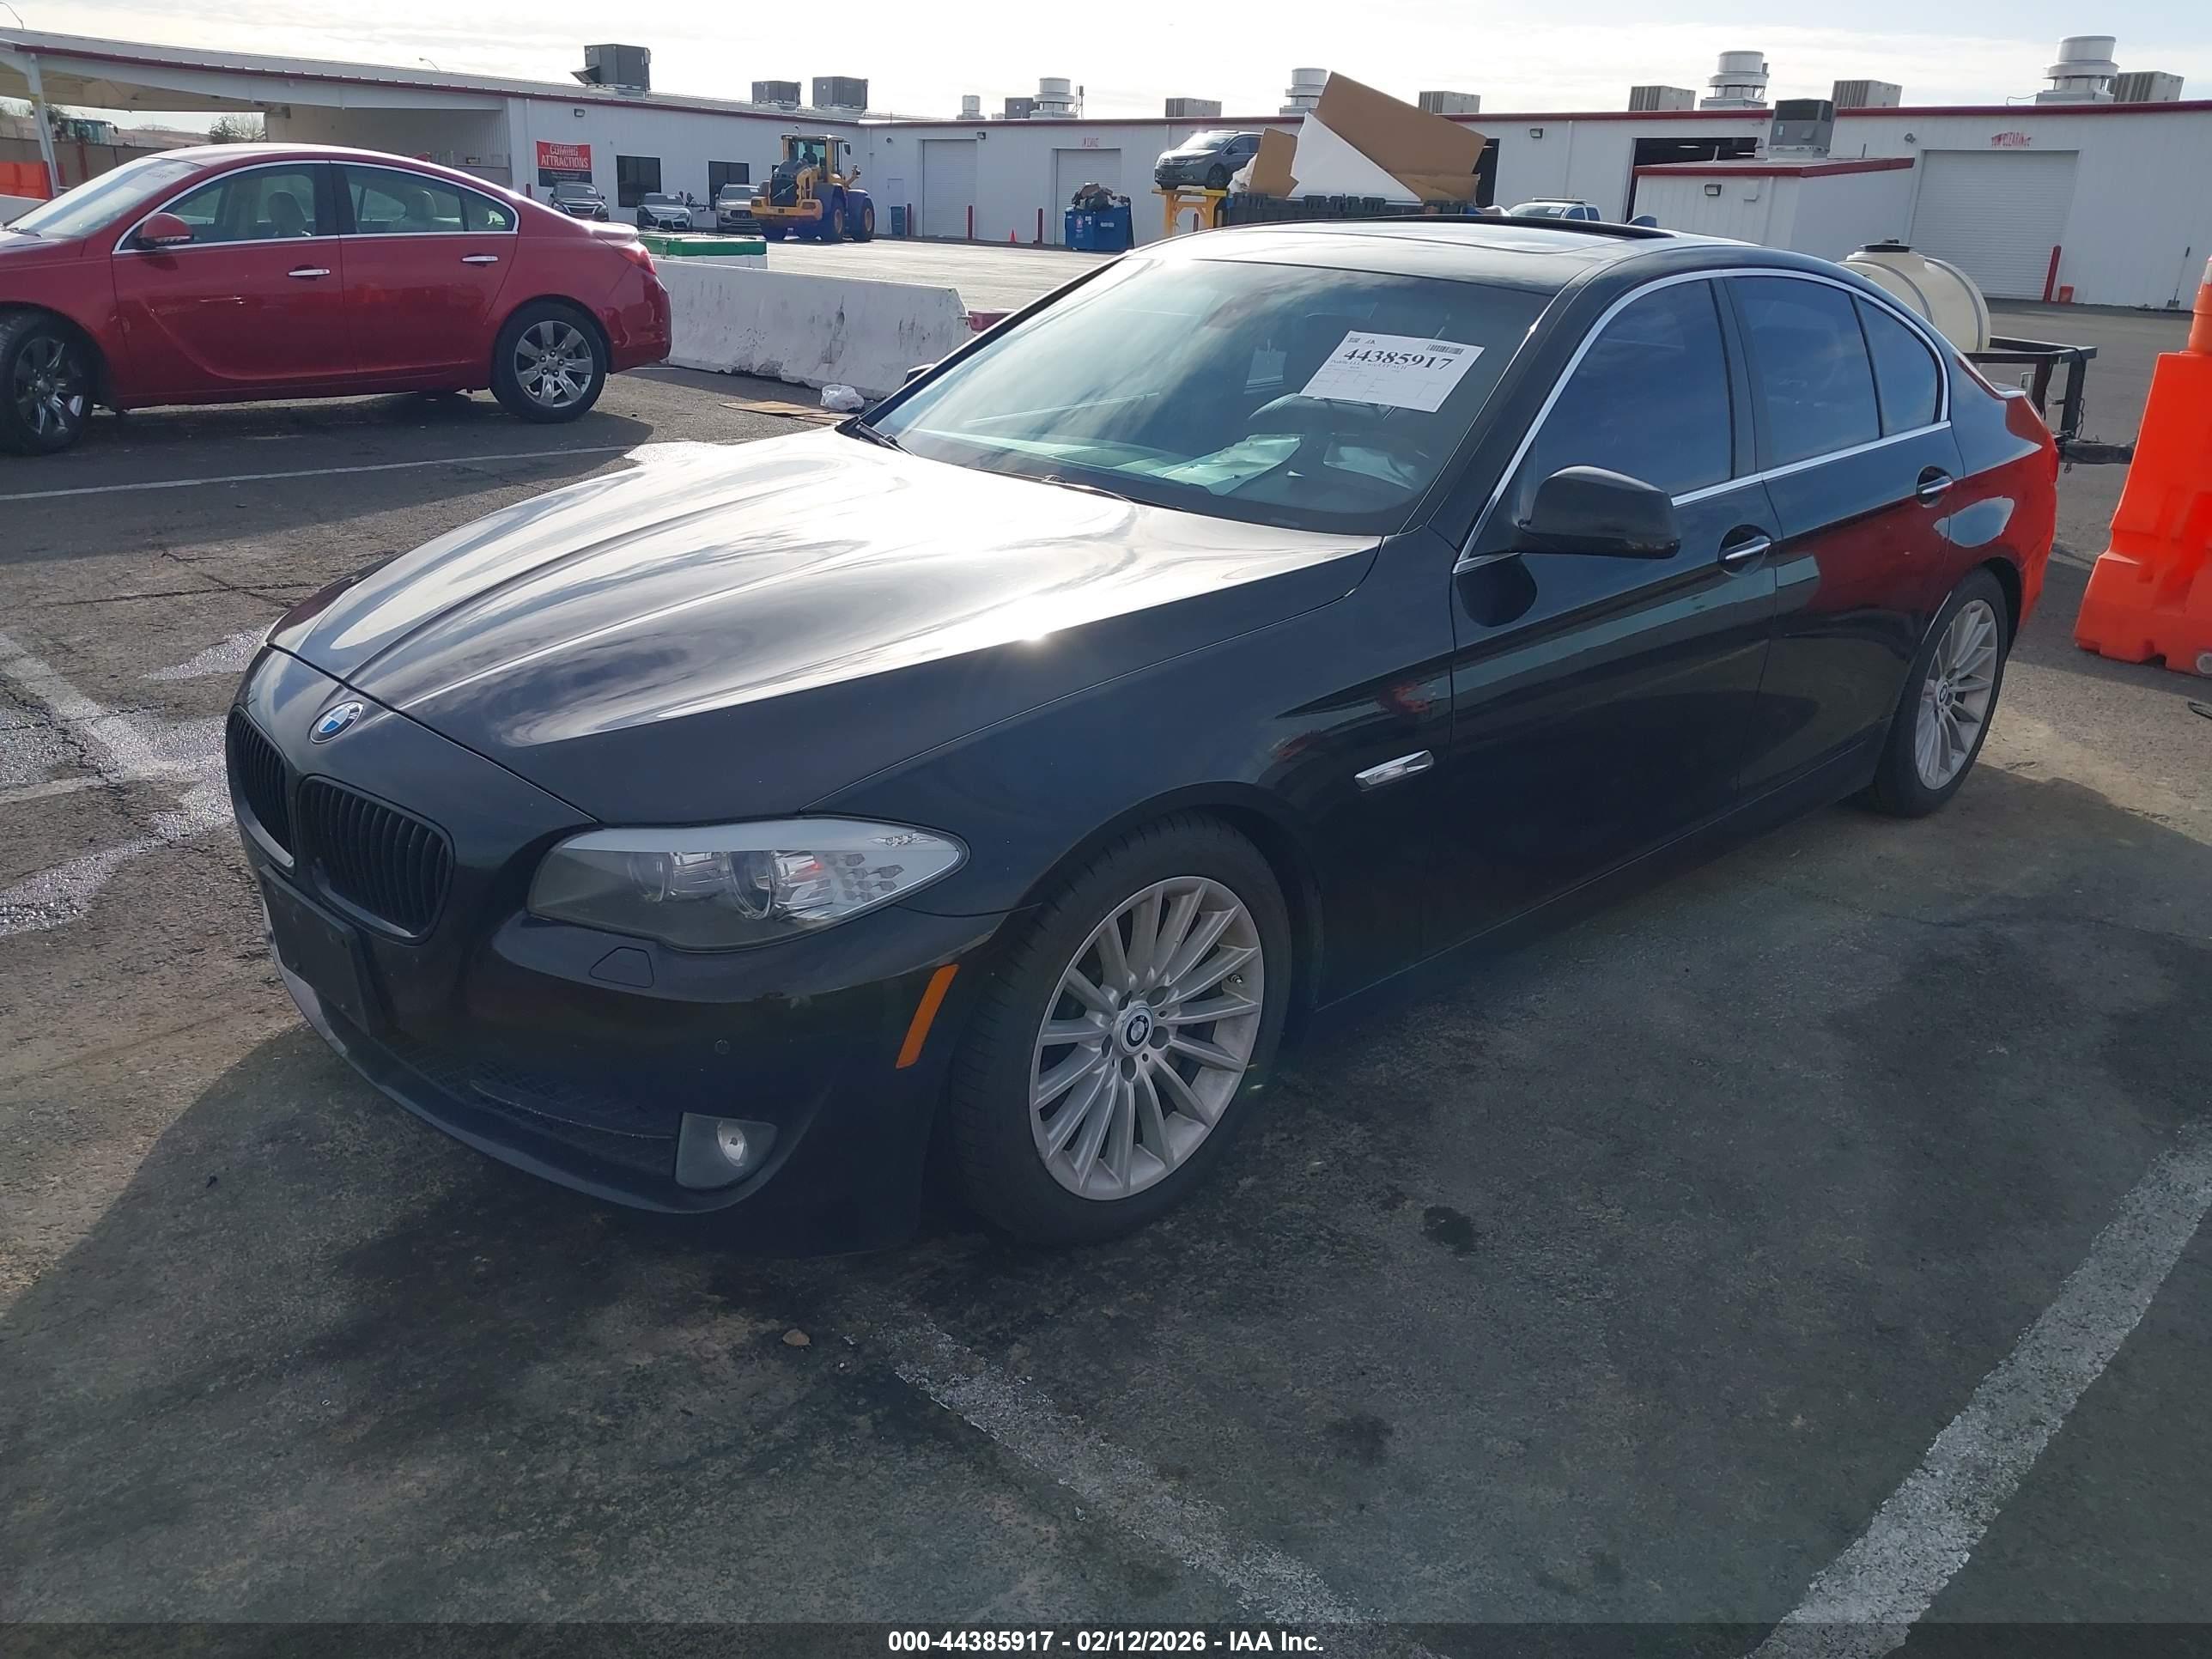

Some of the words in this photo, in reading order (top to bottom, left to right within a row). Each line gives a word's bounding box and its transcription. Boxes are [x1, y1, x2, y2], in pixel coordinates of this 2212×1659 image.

[550, 144, 579, 156] COMING
[541, 155, 589, 168] ATTRACTIONS
[1344, 349, 1454, 370] 44385917
